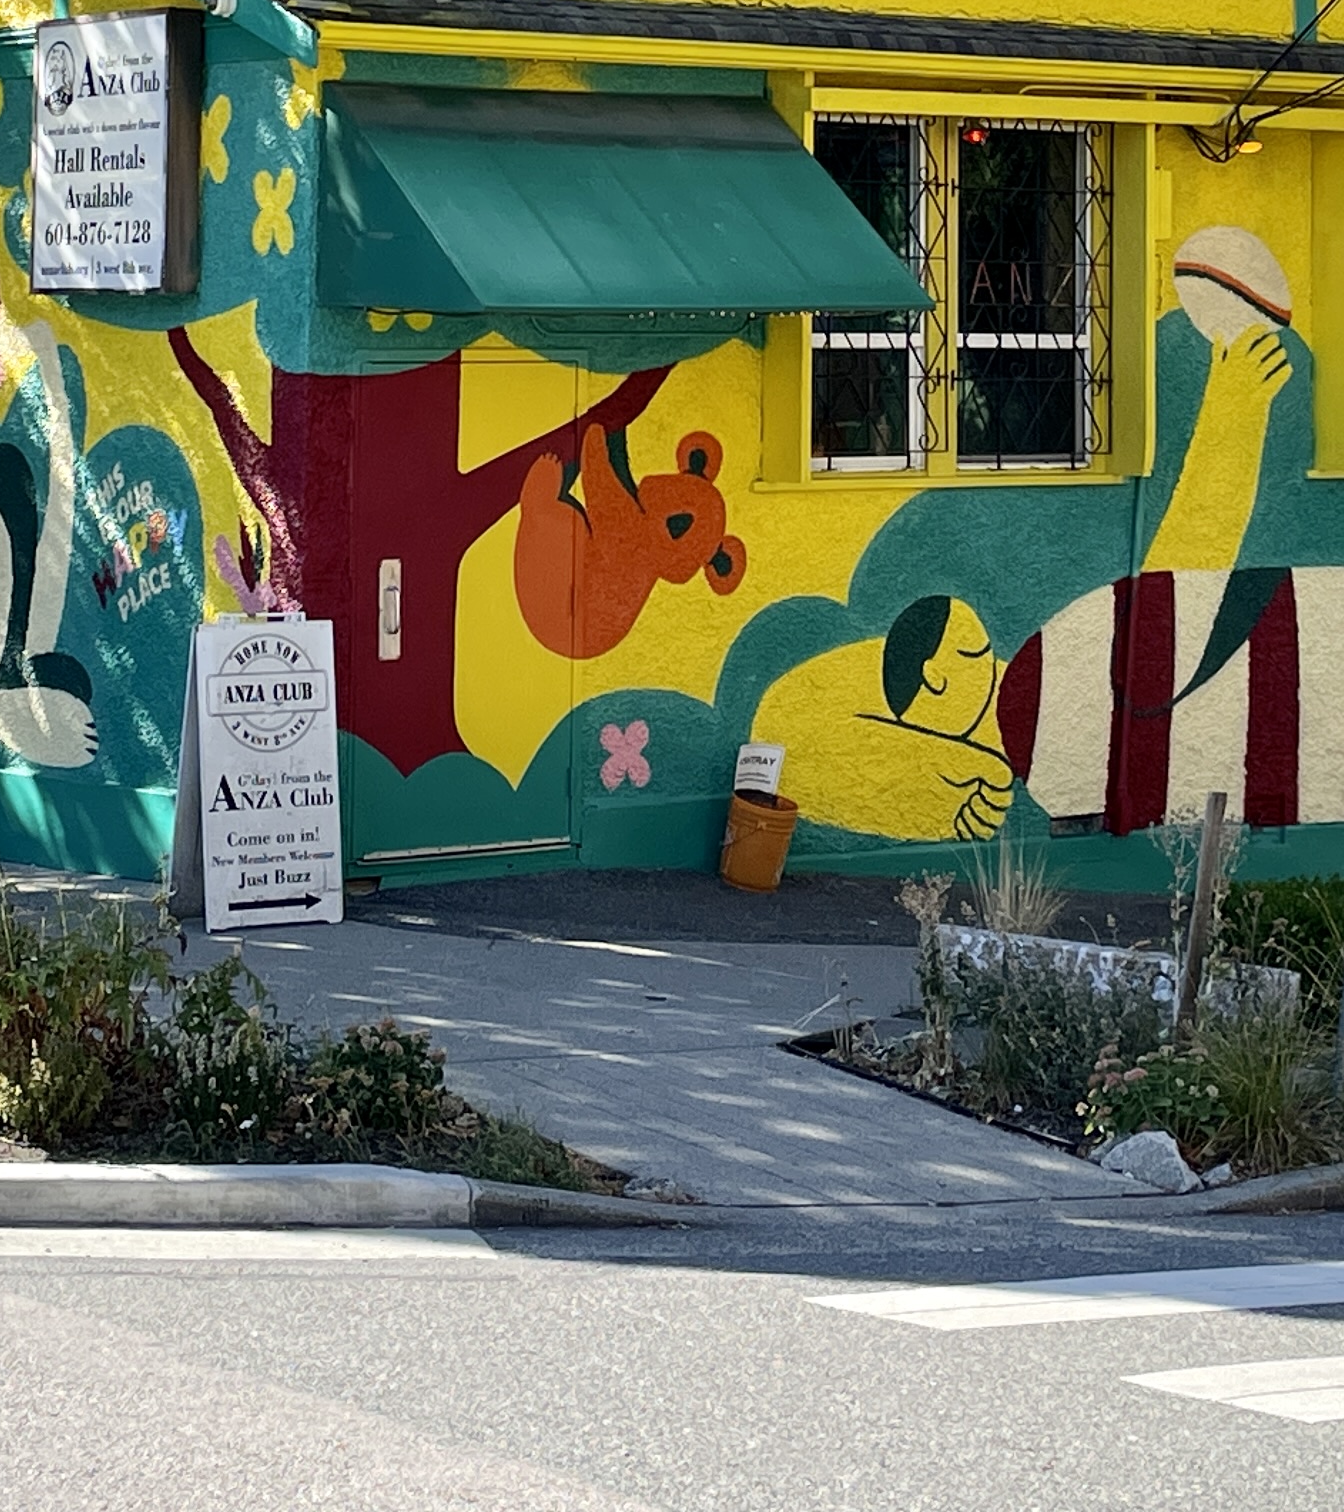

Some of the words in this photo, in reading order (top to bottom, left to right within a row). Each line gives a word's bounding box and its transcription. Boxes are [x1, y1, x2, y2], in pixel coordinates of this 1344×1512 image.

[141, 52, 153, 64] the
[77, 55, 126, 98] ANZA
[130, 70, 160, 93] Club
[54, 148, 85, 175] Hall
[90, 144, 145, 172] Rentals
[64, 181, 134, 210] Available
[45, 220, 152, 246] 604-876-7128
[117, 480, 153, 523] OUR
[92, 506, 187, 610] HAPPY
[117, 563, 172, 624] PLACE
[234, 640, 268, 665] HOME
[275, 641, 301, 664] NOW
[224, 683, 265, 705] ANZA
[273, 681, 313, 702] CLUB
[243, 730, 269, 746] WEST
[281, 772, 311, 785] from
[313, 770, 333, 783] the
[208, 773, 282, 813] ANZA
[290, 787, 334, 808] Club
[227, 831, 271, 847] Come
[276, 833, 295, 844] on
[300, 826, 320, 843] in!
[211, 855, 235, 867] New
[238, 852, 286, 865] Members
[289, 850, 335, 862] Welcome
[238, 871, 268, 889] Just
[275, 869, 312, 885] Buzz
